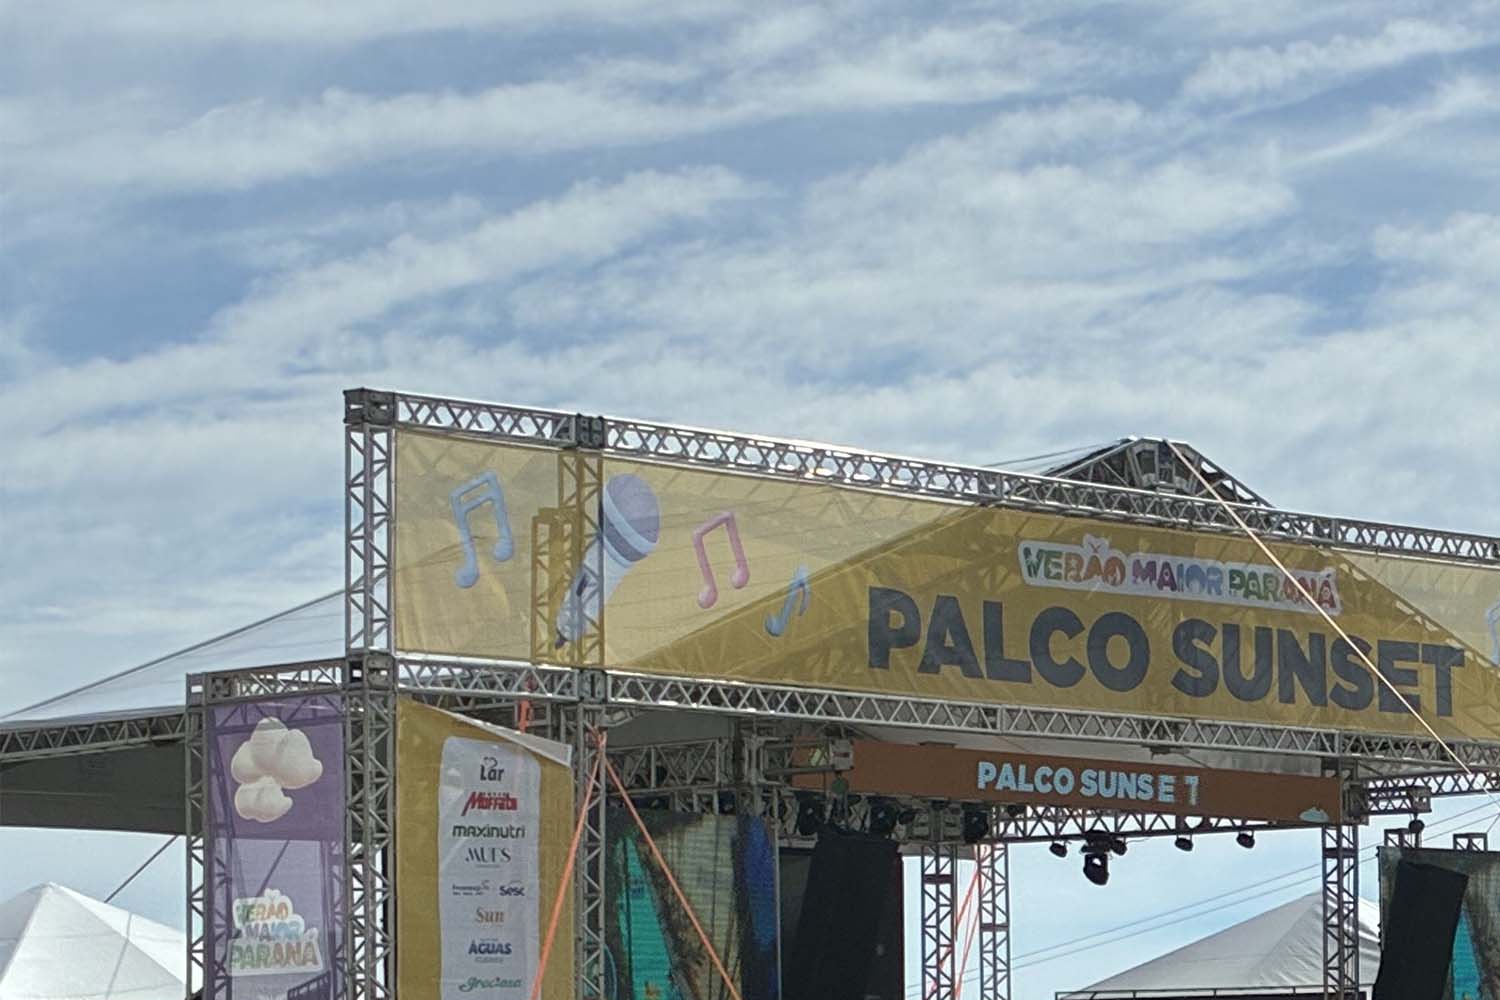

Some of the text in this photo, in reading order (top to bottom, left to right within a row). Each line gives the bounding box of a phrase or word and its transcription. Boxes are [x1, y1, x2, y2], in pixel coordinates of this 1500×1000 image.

[1023, 544, 1337, 608] VERÃO MAIOR PARANÁ
[868, 587, 1465, 717] PALCO SUNSET
[977, 761, 1075, 795] PALCO
[452, 824, 526, 838] maxinutri
[476, 907, 504, 923] Sun
[229, 930, 319, 970] PARANÁ
[468, 940, 512, 955] ÁGUAS
